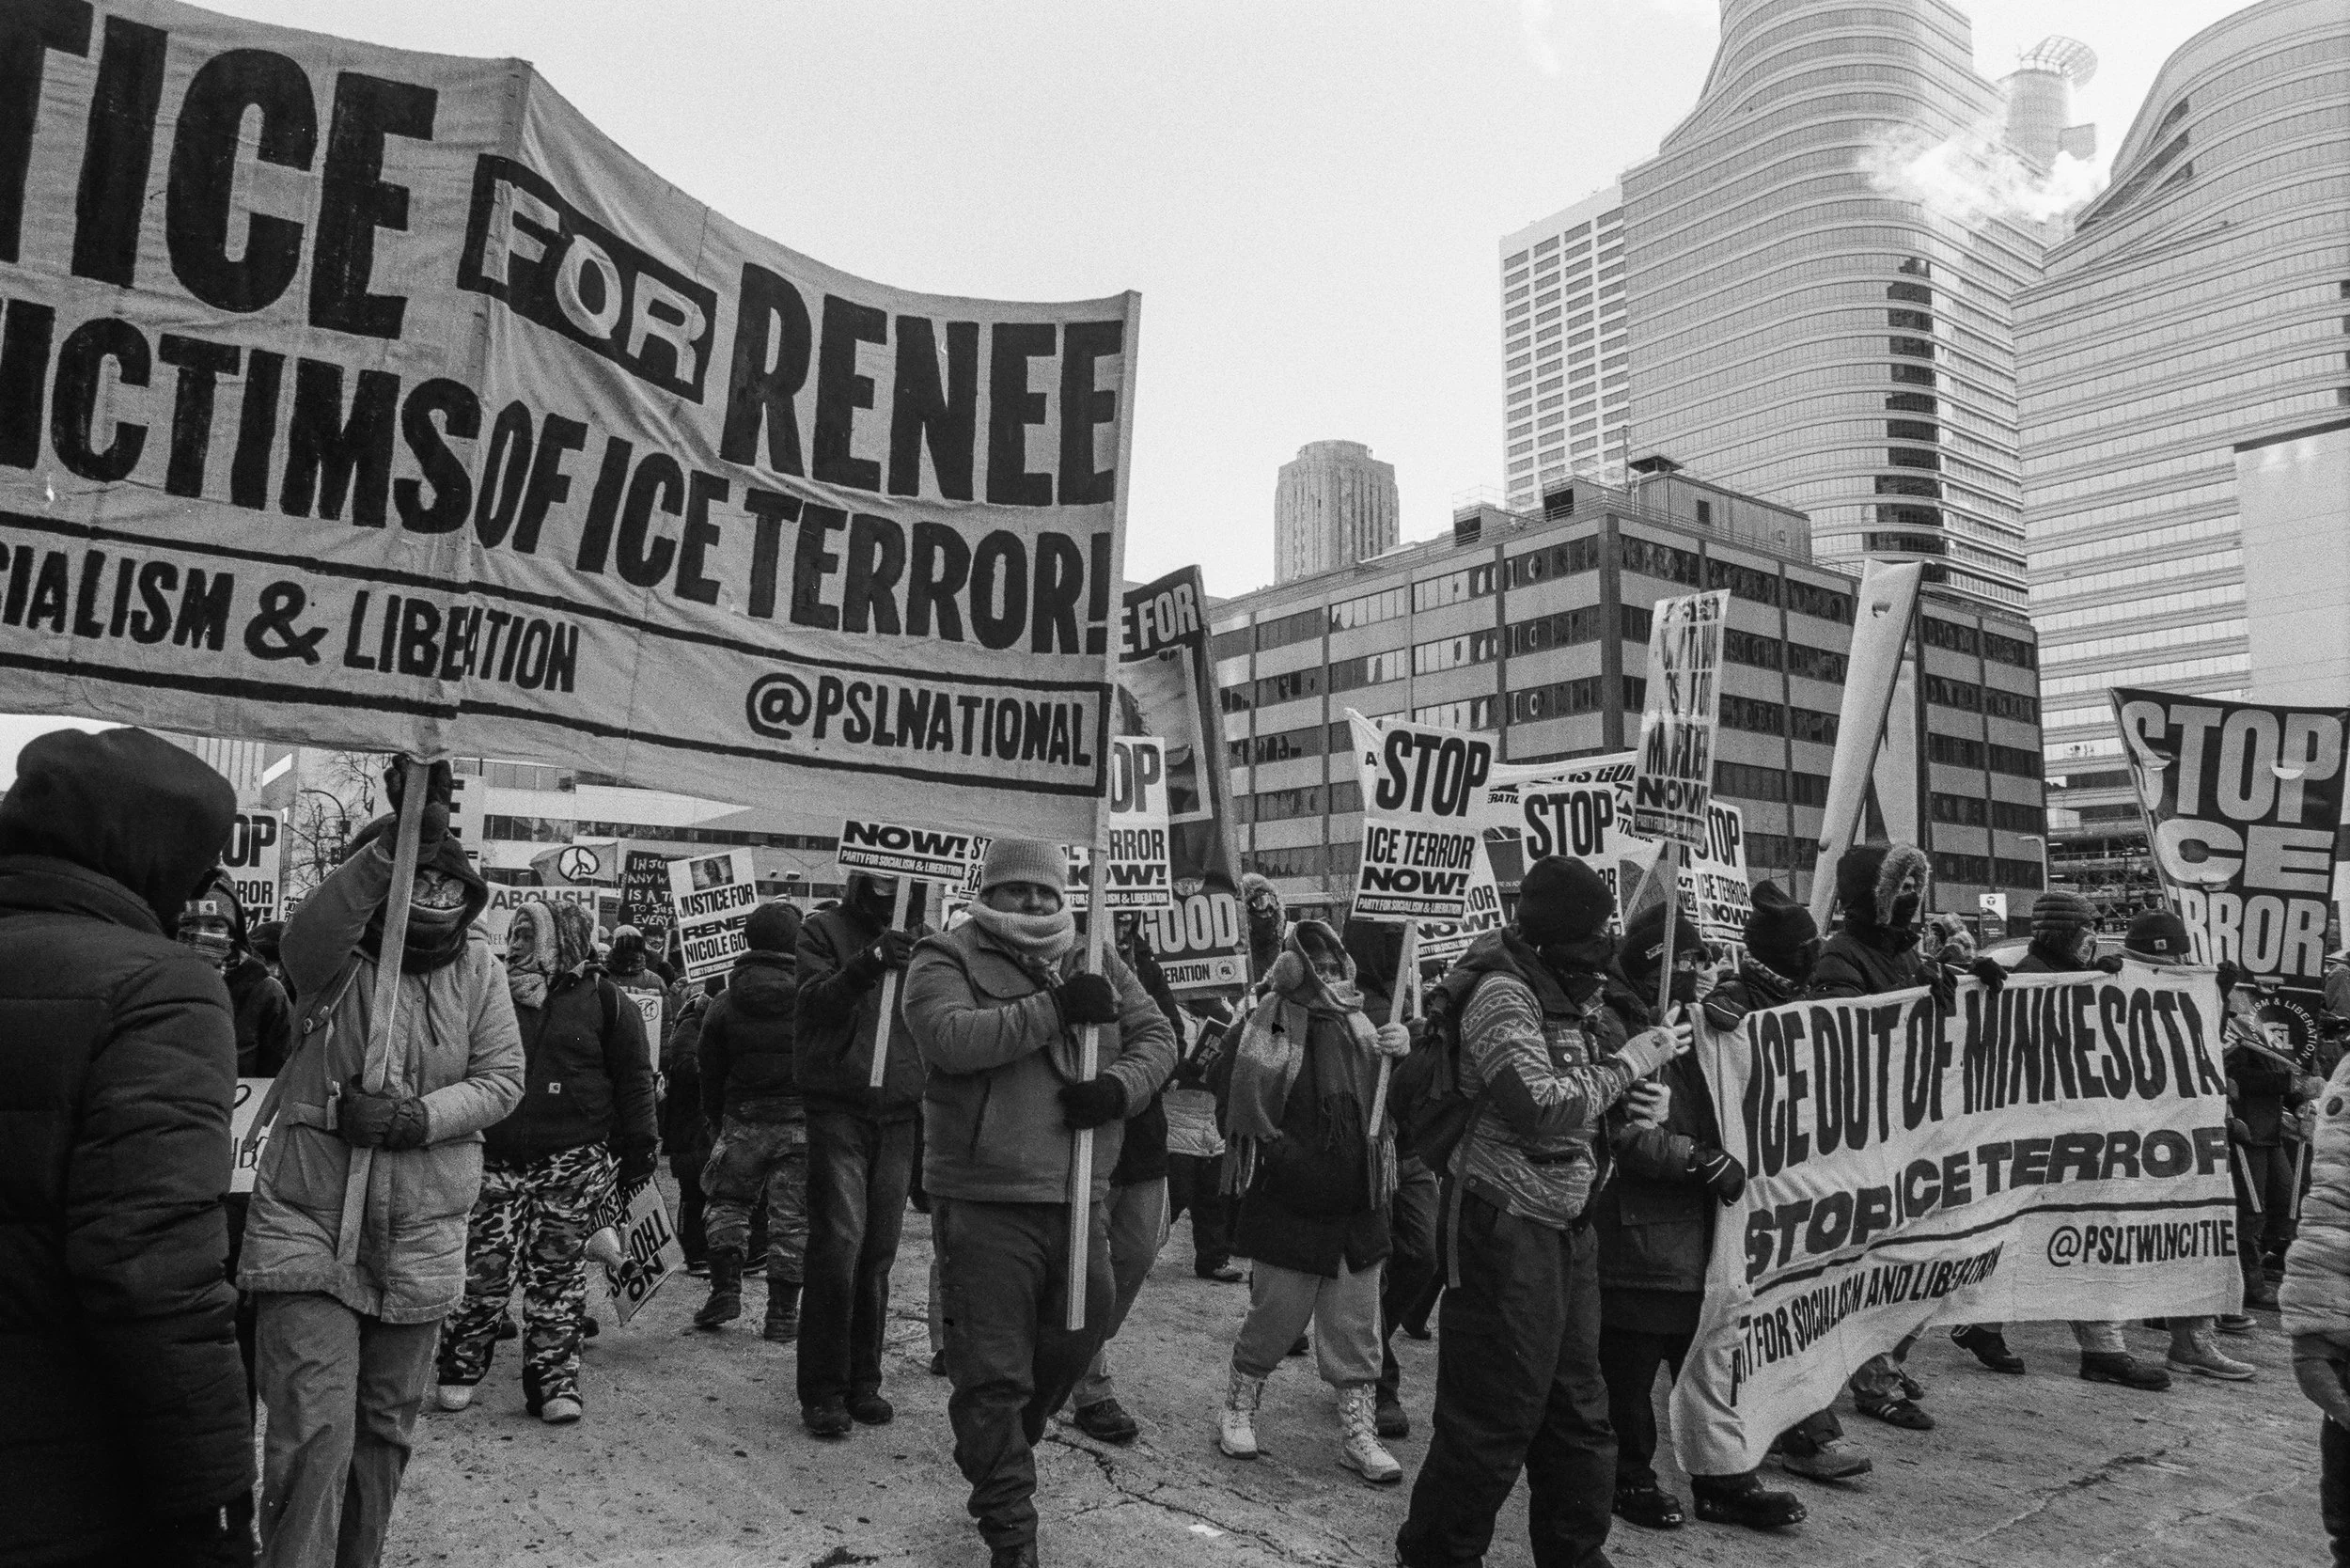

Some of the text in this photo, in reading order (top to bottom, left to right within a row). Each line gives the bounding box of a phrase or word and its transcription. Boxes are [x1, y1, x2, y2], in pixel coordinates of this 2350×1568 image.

[480, 177, 1123, 508] FOR RENEE
[0, 297, 1111, 656] ICTIMS OF ICE TERROR!
[243, 579, 328, 666] &
[343, 589, 579, 694] LIBEATION
[1137, 583, 1200, 651] FOR
[745, 671, 1092, 768] @PSLNATIONAL
[2121, 699, 2343, 823] STOP
[1375, 729, 1492, 817] STOP
[840, 849, 964, 877] PARTY FOR SOCIALISM & LIBERATION
[843, 820, 969, 859] NOW!
[1365, 826, 1476, 870] ICE TERROR
[1524, 789, 1614, 862] STOP
[629, 902, 647, 913] TO
[678, 888, 730, 918] JUSTICE
[729, 883, 755, 908] FOR
[1360, 865, 1470, 897] NOW!
[684, 935, 728, 964] NICOLE
[1742, 1011, 1810, 1180] ICE
[1902, 994, 1958, 1132] OF
[1963, 984, 2228, 1116] MINNESOTA
[605, 1209, 672, 1299] TROS
[1744, 1184, 1891, 1284] STOP
[1893, 1151, 1972, 1228] ICE
[1753, 1306, 1794, 1367] FOR
[1792, 1271, 1866, 1352] SOCIALISM
[1863, 1263, 1914, 1309] AND
